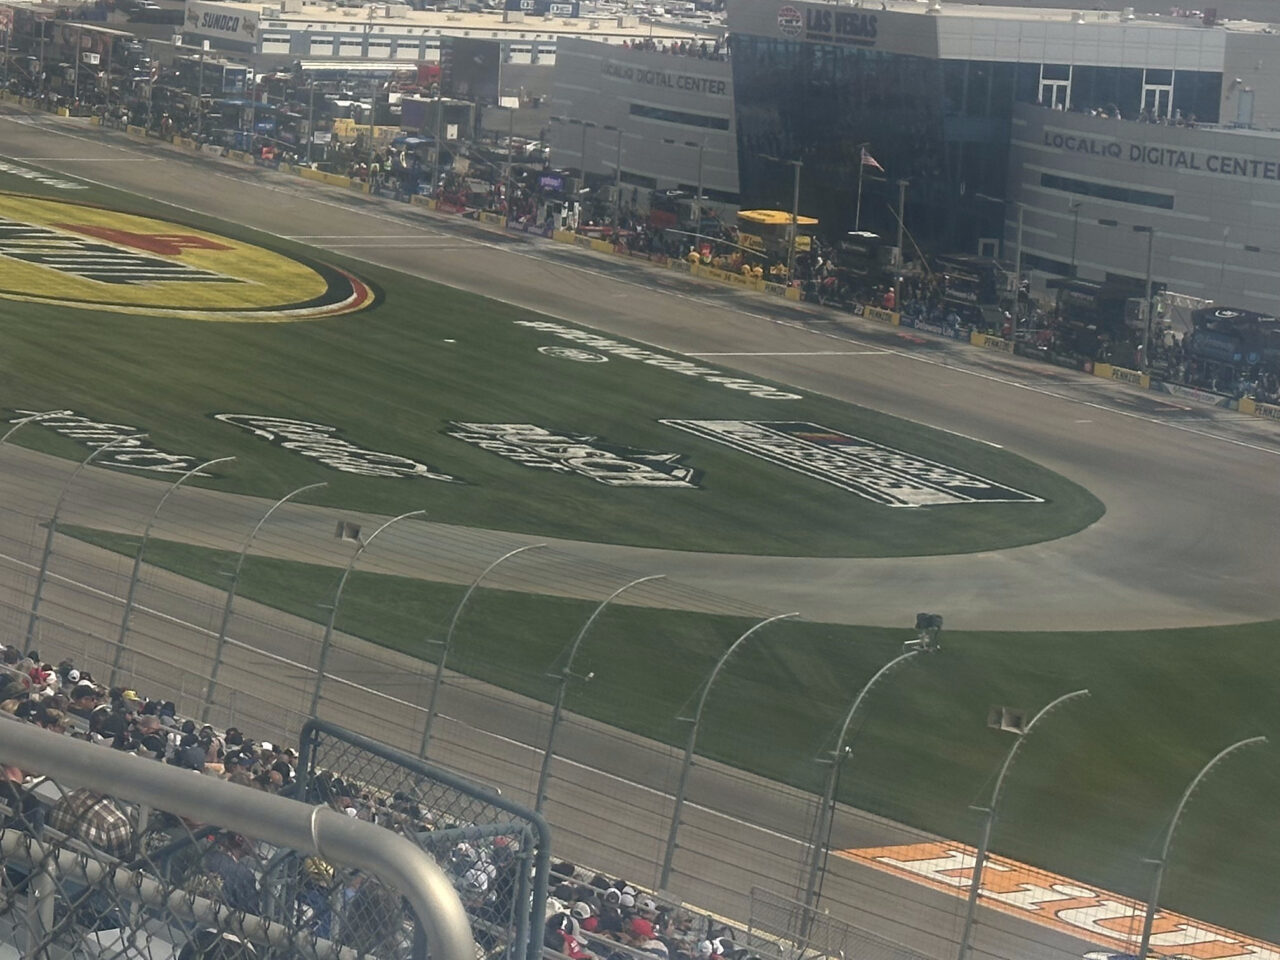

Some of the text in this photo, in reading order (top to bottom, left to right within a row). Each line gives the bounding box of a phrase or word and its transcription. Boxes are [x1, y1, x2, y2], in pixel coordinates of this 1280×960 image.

[201, 11, 239, 33] SUNOCO
[806, 7, 833, 33] LAS
[834, 11, 878, 39] VEGAS
[637, 69, 674, 89] DIGITAL
[676, 75, 727, 96] CENTER
[1129, 143, 1201, 170] DIGITAL
[1206, 154, 1280, 181] CENTE
[448, 420, 700, 488] BUSCH
[825, 444, 994, 489] NASCAR
